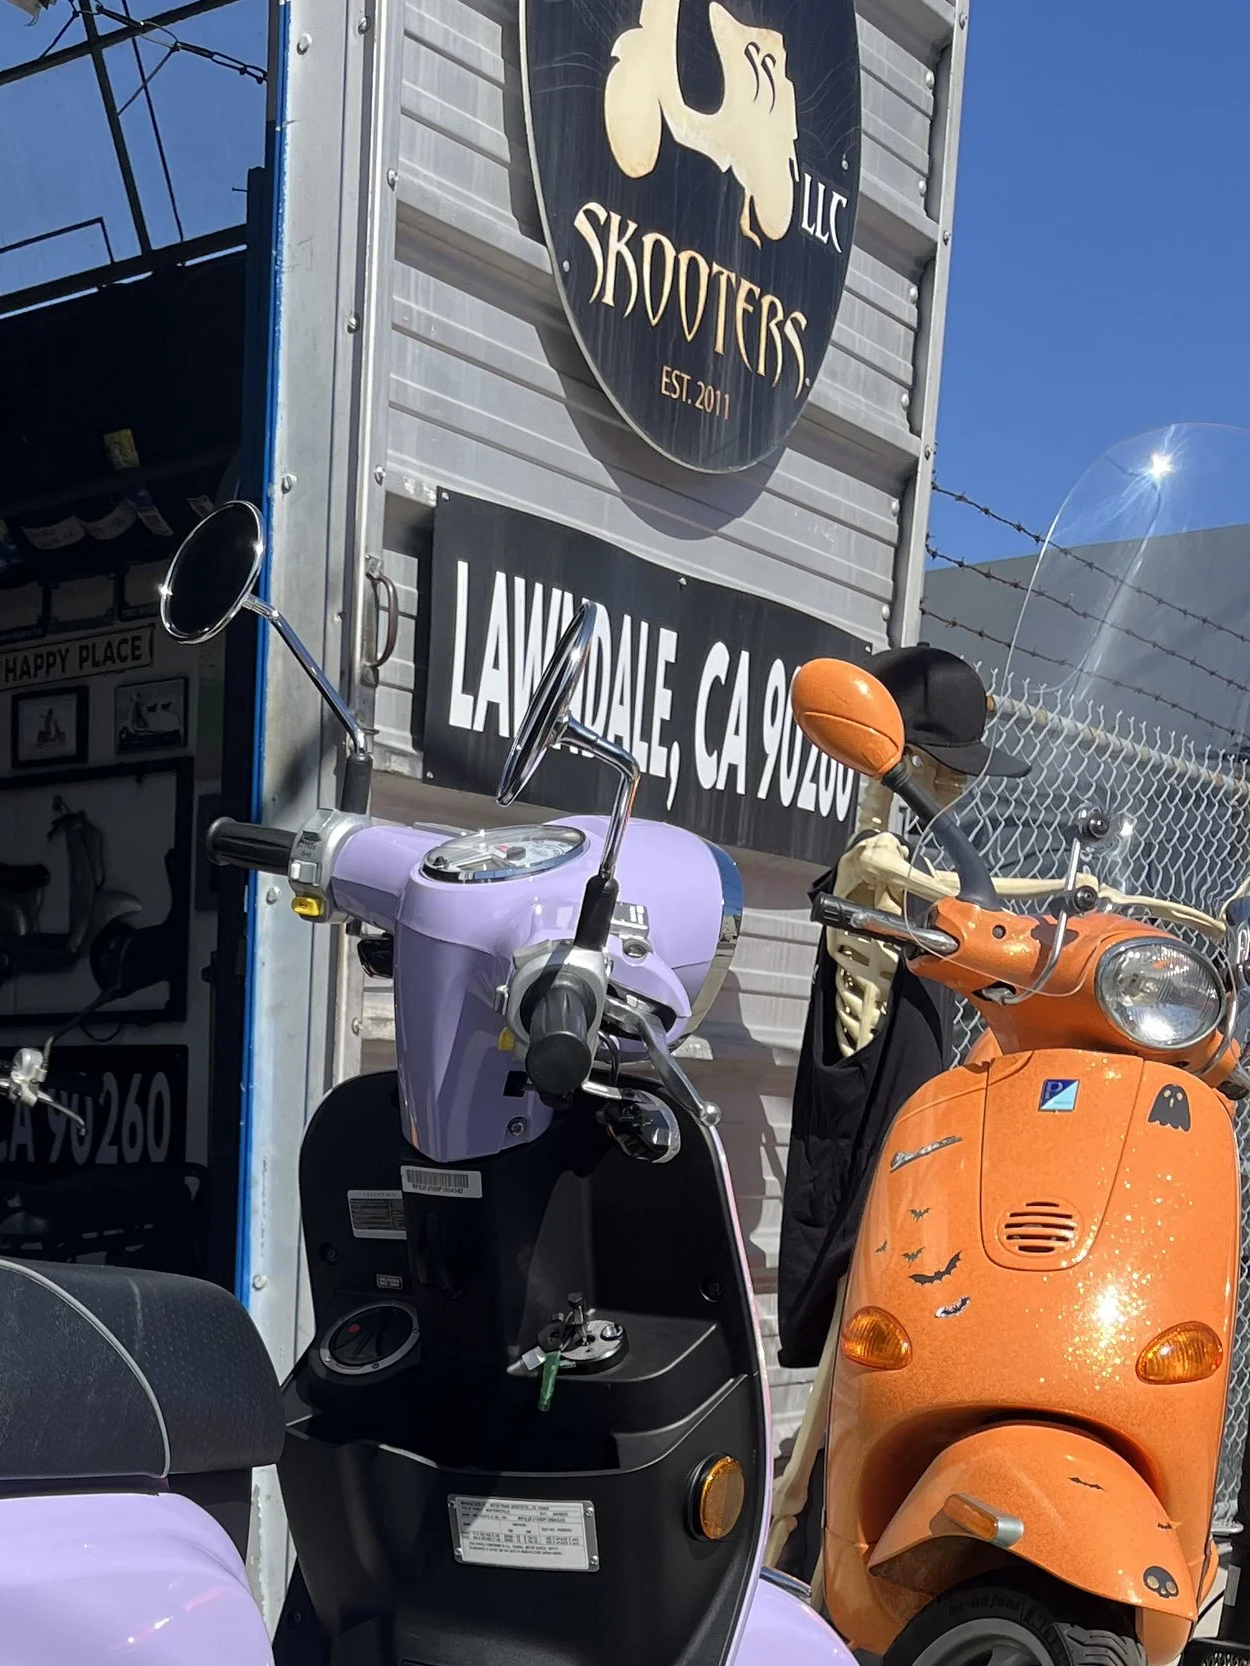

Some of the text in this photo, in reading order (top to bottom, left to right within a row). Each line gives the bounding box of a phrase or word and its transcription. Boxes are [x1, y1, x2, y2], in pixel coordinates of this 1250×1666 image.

[801, 173, 848, 253] LLC
[573, 201, 808, 400] SKOOTERS
[660, 365, 731, 421] EST. 2011
[4, 647, 70, 683] HAPPY
[78, 634, 143, 670] PLACE
[694, 641, 750, 795] CA
[47, 1070, 173, 1167] 90260
